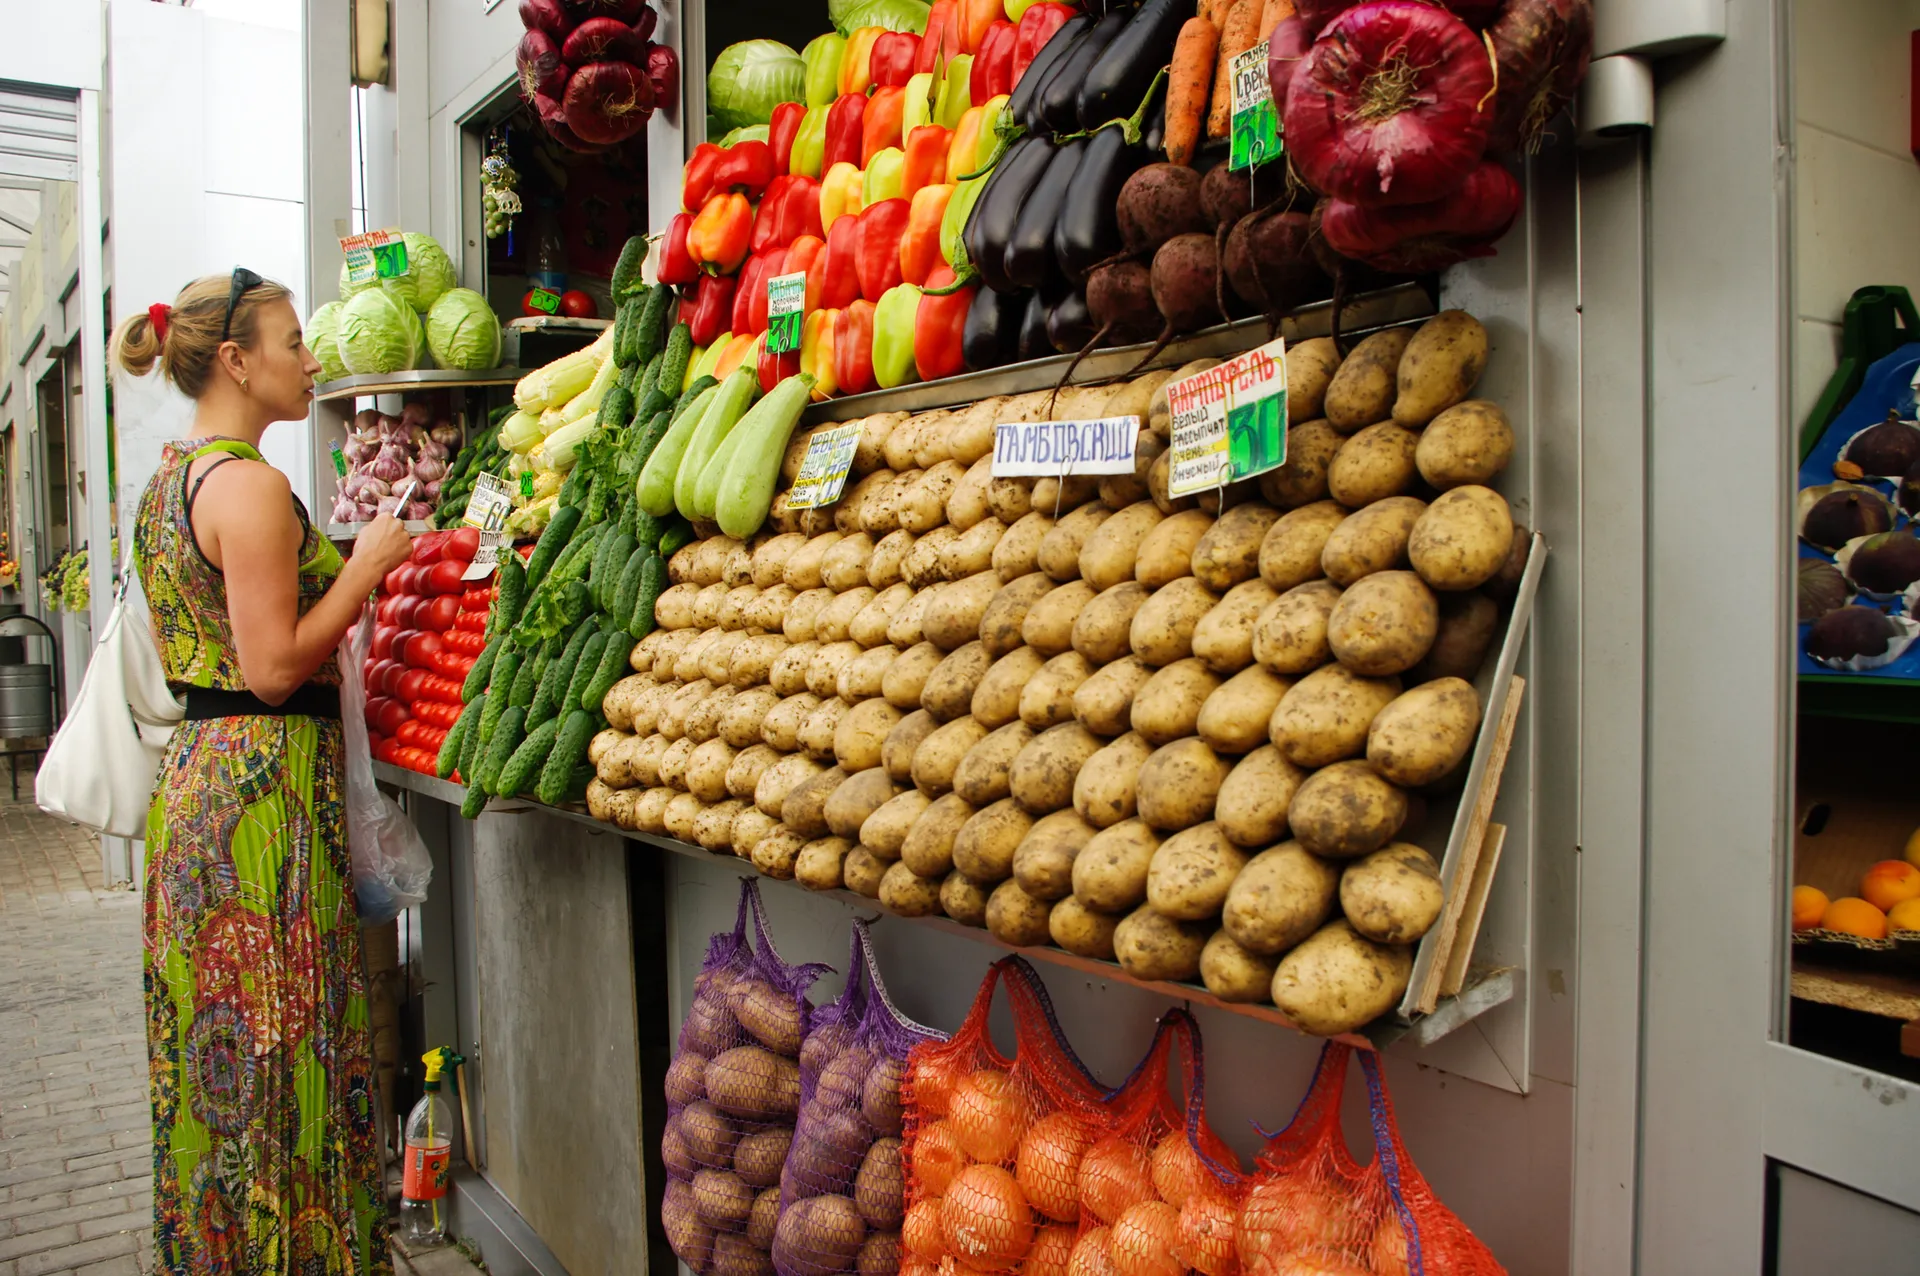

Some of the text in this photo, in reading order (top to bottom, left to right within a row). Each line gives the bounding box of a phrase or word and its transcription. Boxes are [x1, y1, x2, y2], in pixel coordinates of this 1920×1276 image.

[1168, 350, 1275, 416] КАРТОФЕЛЬ
[996, 419, 1133, 464] ТАМБОВСКИЙ
[1229, 390, 1286, 480] 30
